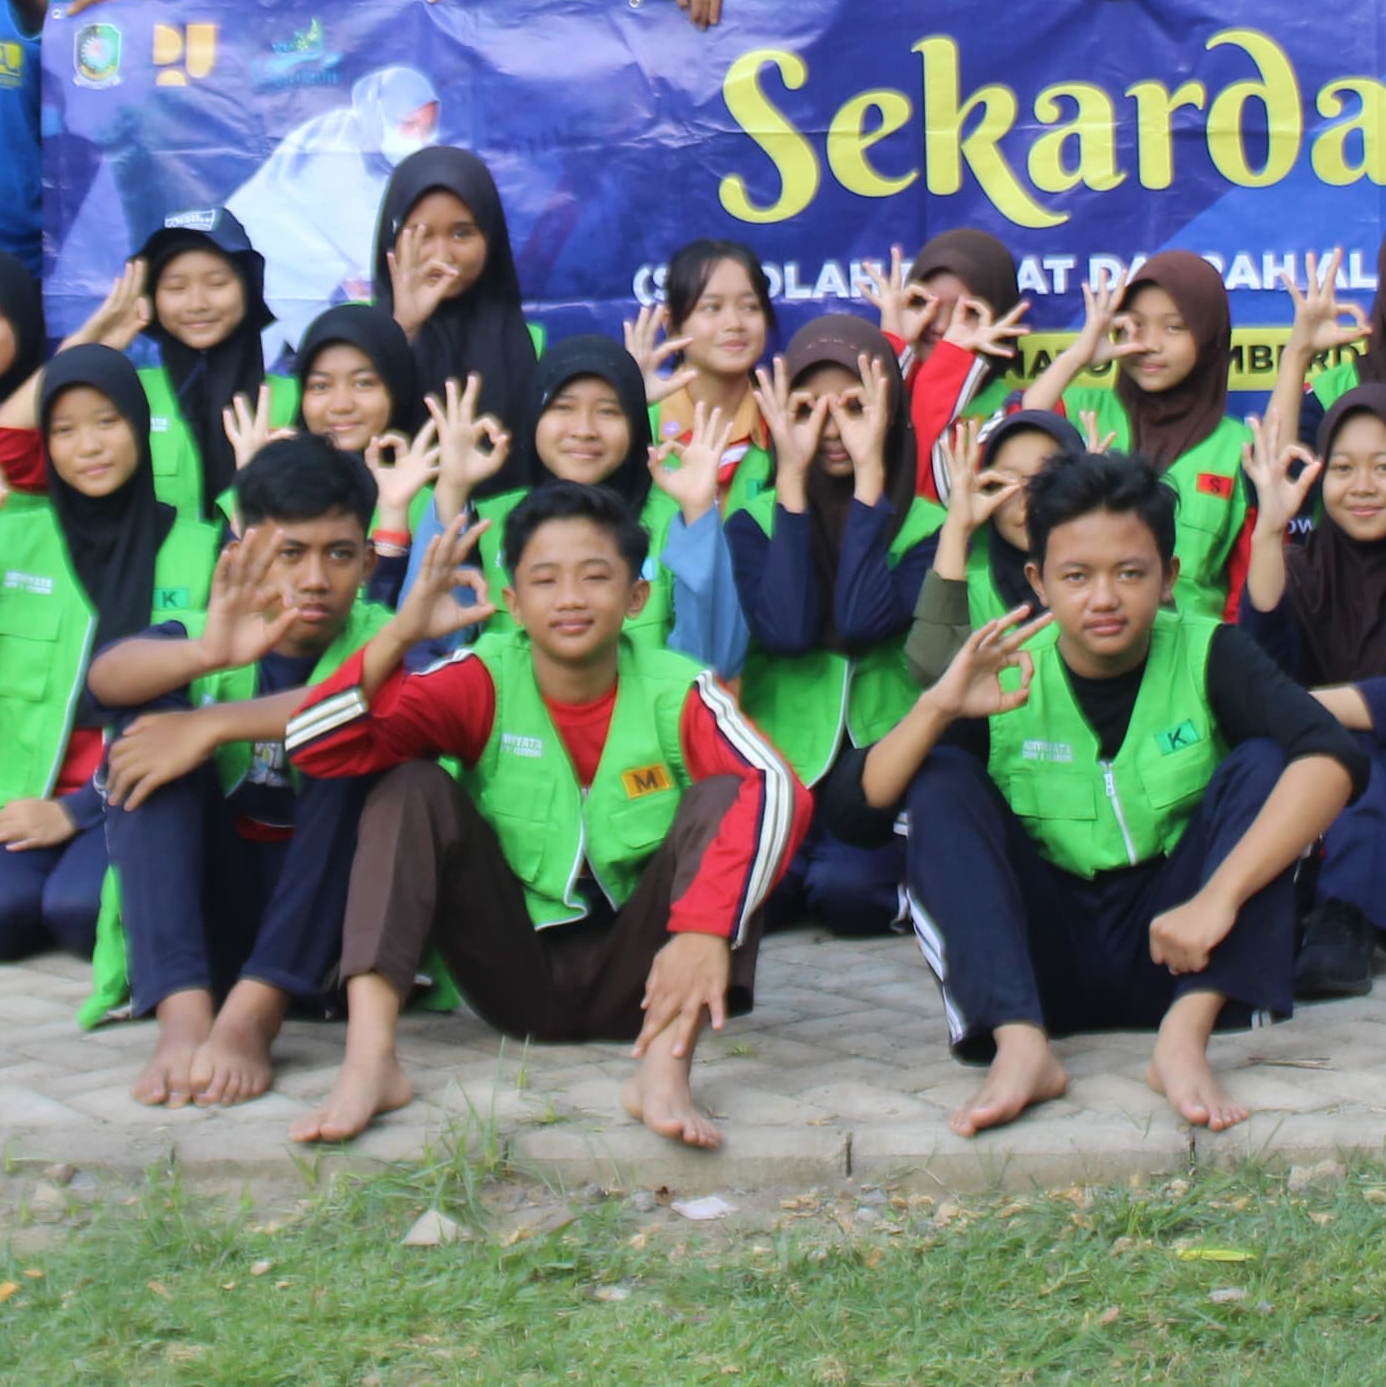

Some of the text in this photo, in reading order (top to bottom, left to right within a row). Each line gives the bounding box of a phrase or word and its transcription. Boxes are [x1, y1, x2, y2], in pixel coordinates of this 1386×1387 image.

[162, 590, 179, 608] K
[1166, 726, 1188, 750] K
[632, 768, 659, 793] M
